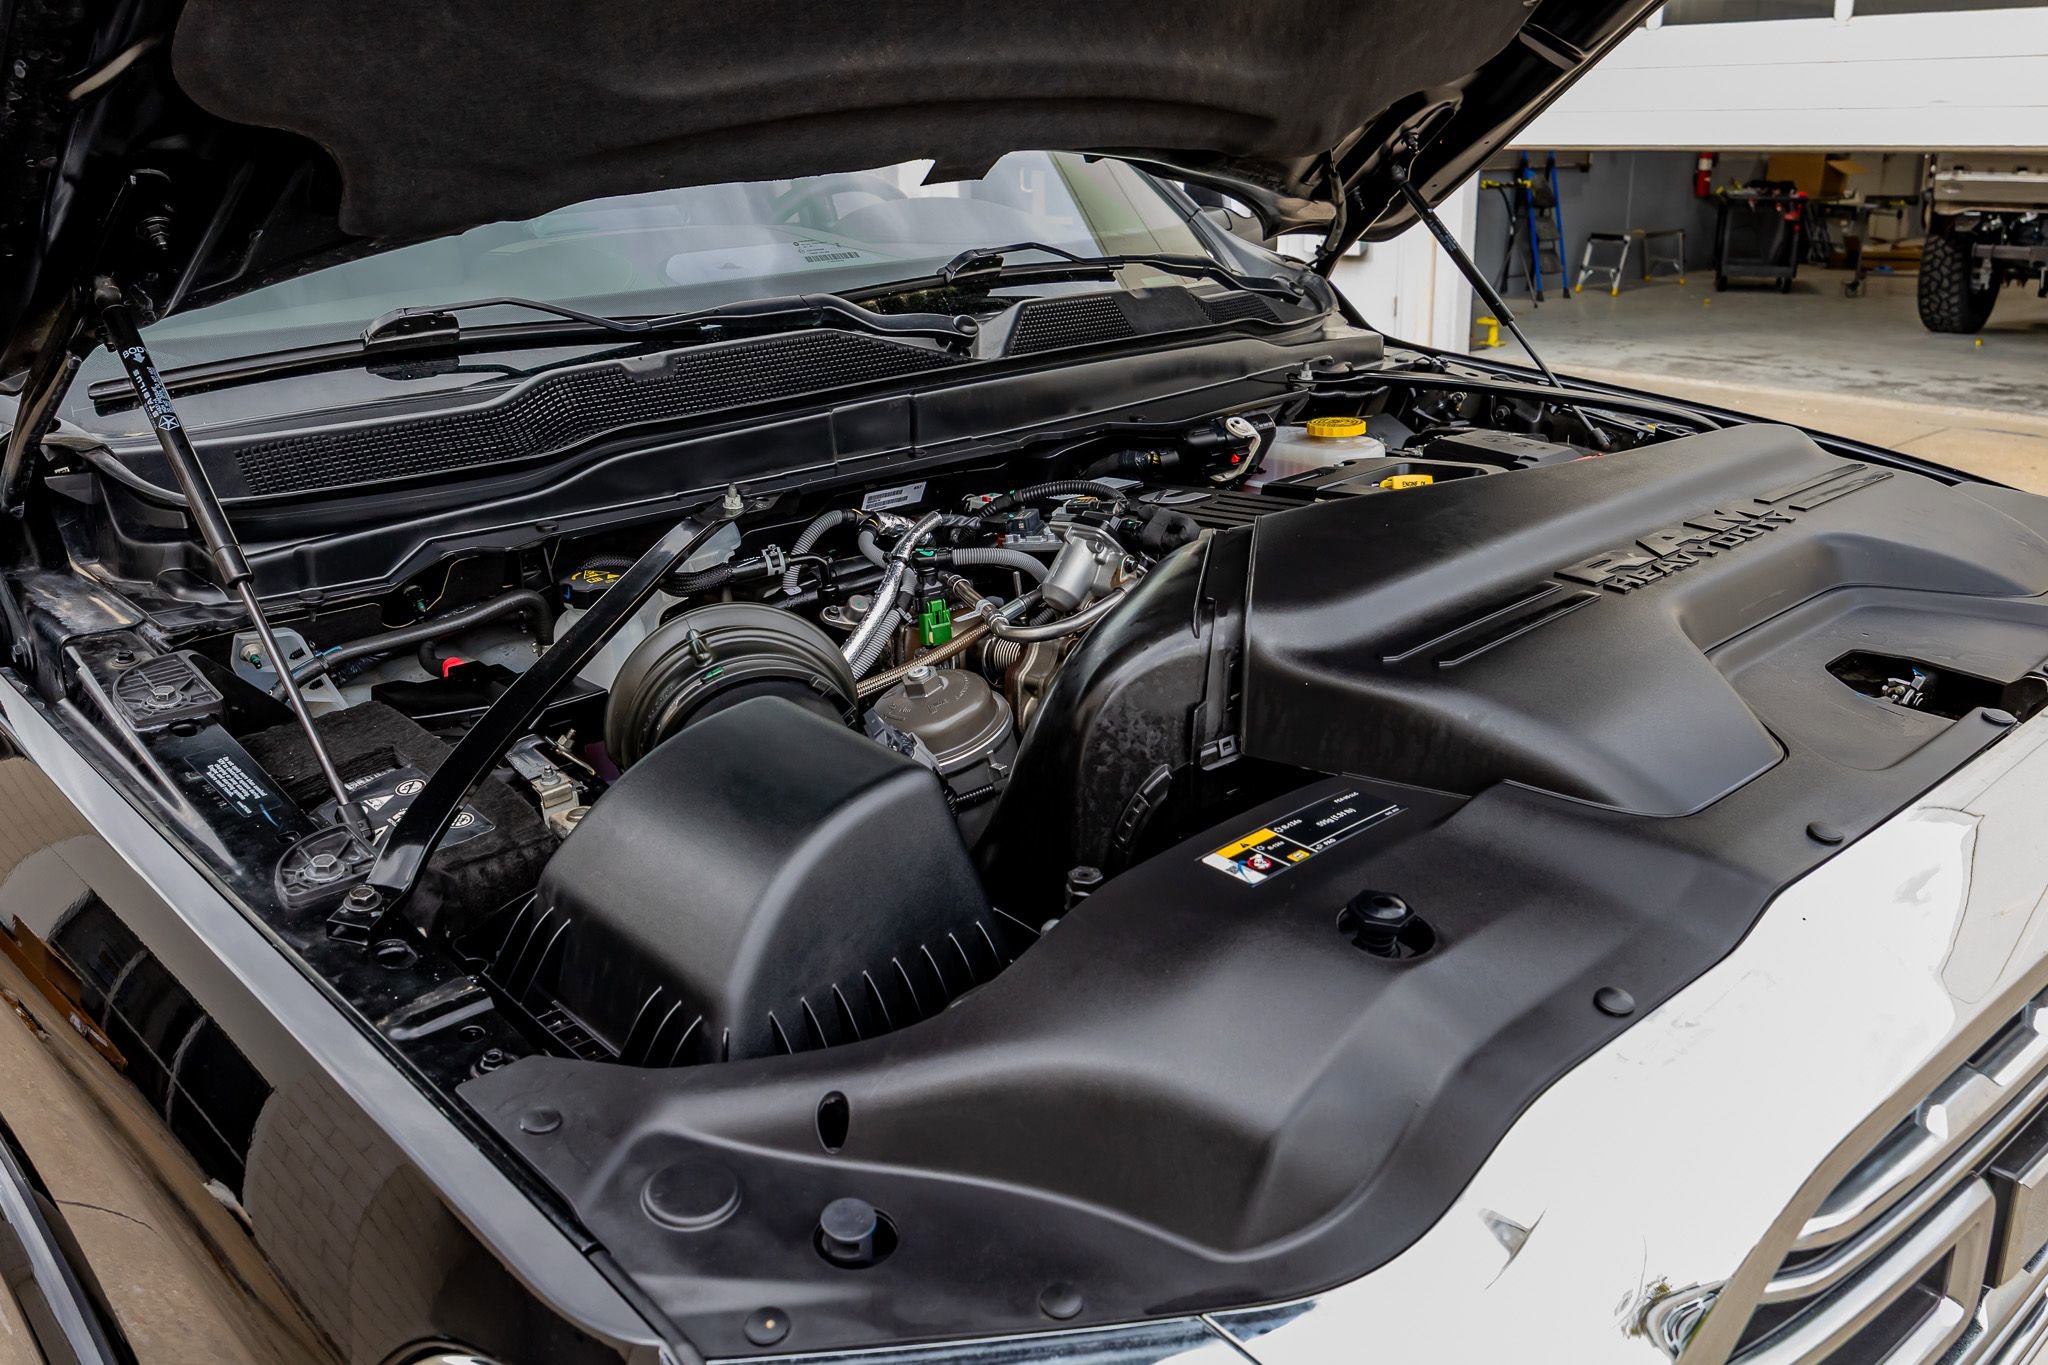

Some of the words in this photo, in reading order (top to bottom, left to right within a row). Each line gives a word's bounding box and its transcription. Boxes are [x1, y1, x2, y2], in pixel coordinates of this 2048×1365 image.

[122, 346, 145, 359] BOD
[132, 369, 159, 418] STABILUS
[1553, 502, 1775, 586] RAM
[1602, 545, 1719, 594] HEAVY
[1709, 512, 1796, 550] DUTY
